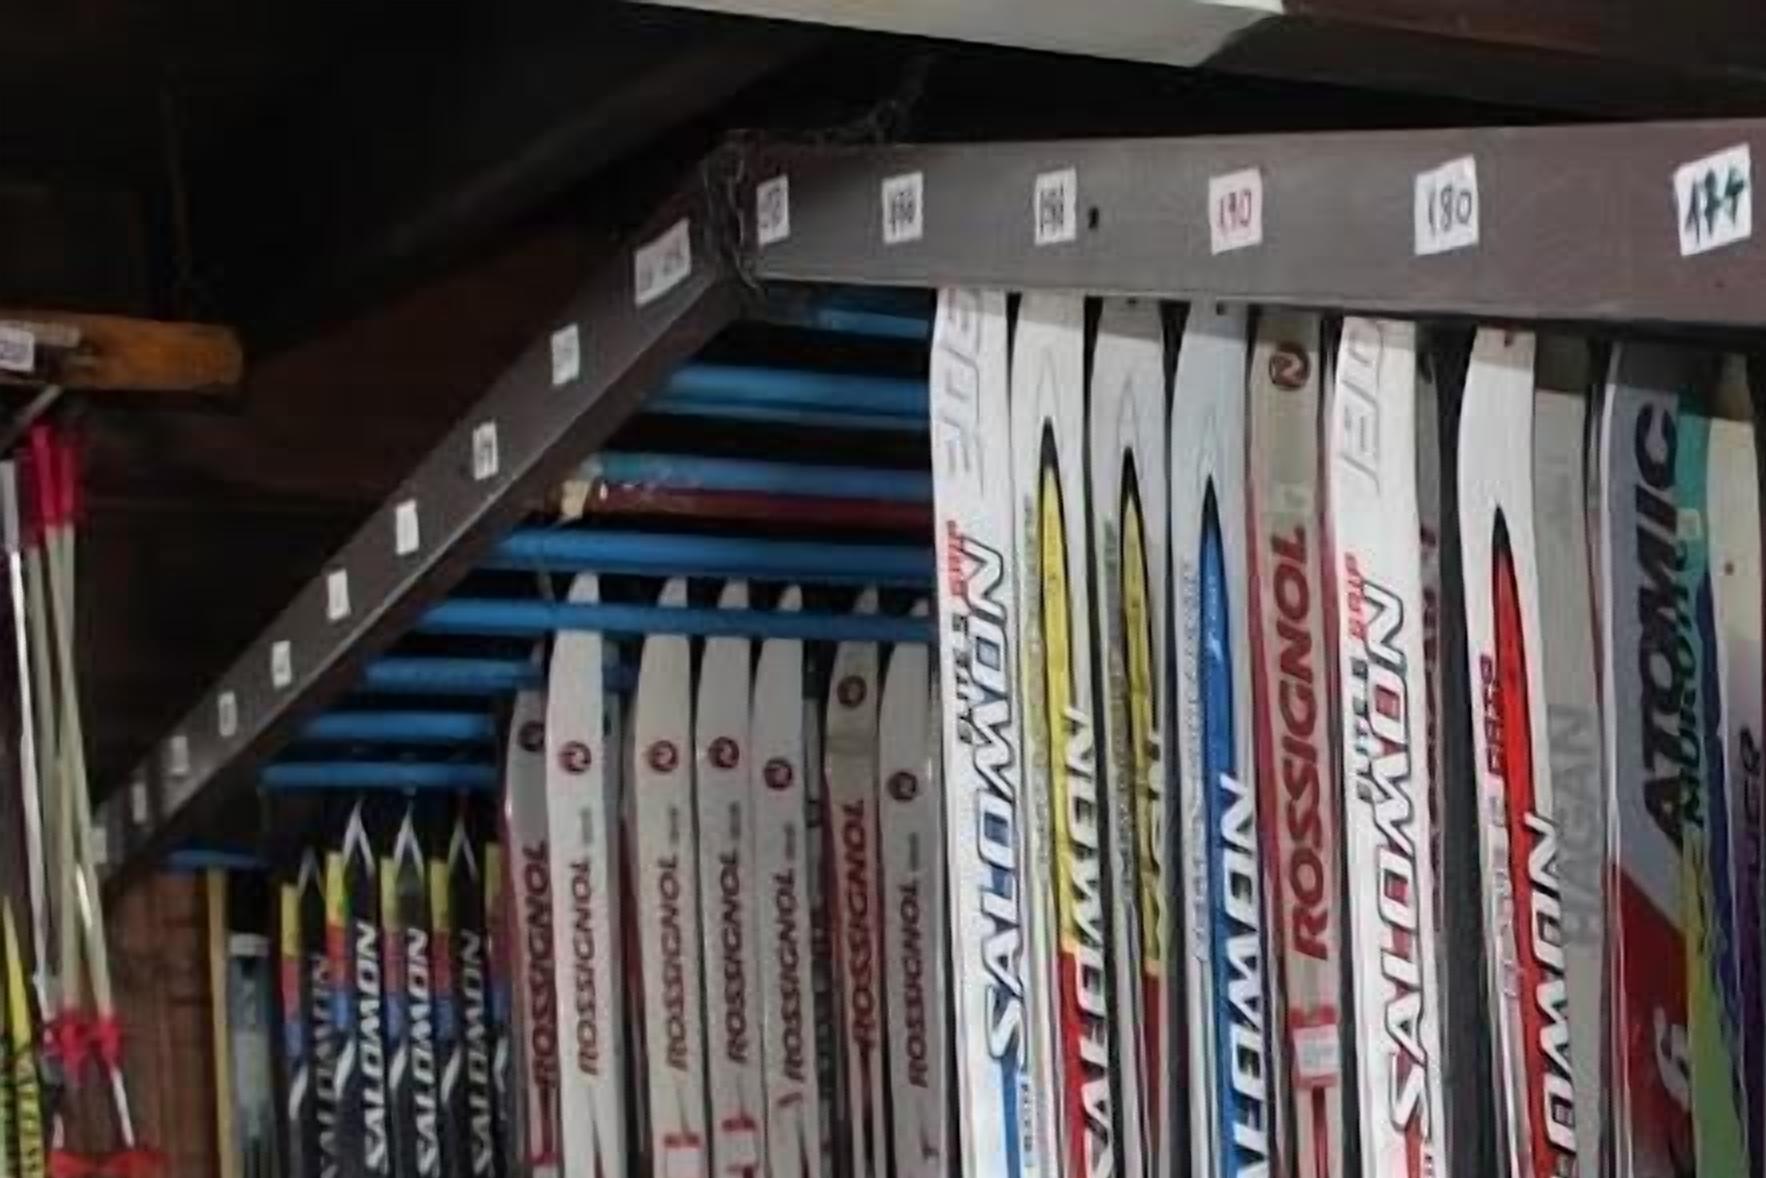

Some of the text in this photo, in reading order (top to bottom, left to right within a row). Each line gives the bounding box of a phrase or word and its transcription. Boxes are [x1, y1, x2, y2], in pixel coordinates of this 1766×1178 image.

[1425, 186, 1472, 235] 180
[963, 535, 1025, 1075] SALOMON
[1272, 525, 1330, 960] ROSSIGNOL
[1634, 402, 1684, 848] ATOMIC
[356, 920, 389, 1175] SALOMON
[461, 929, 494, 1178] SALOMON
[1364, 580, 1431, 1142] SALOMON
